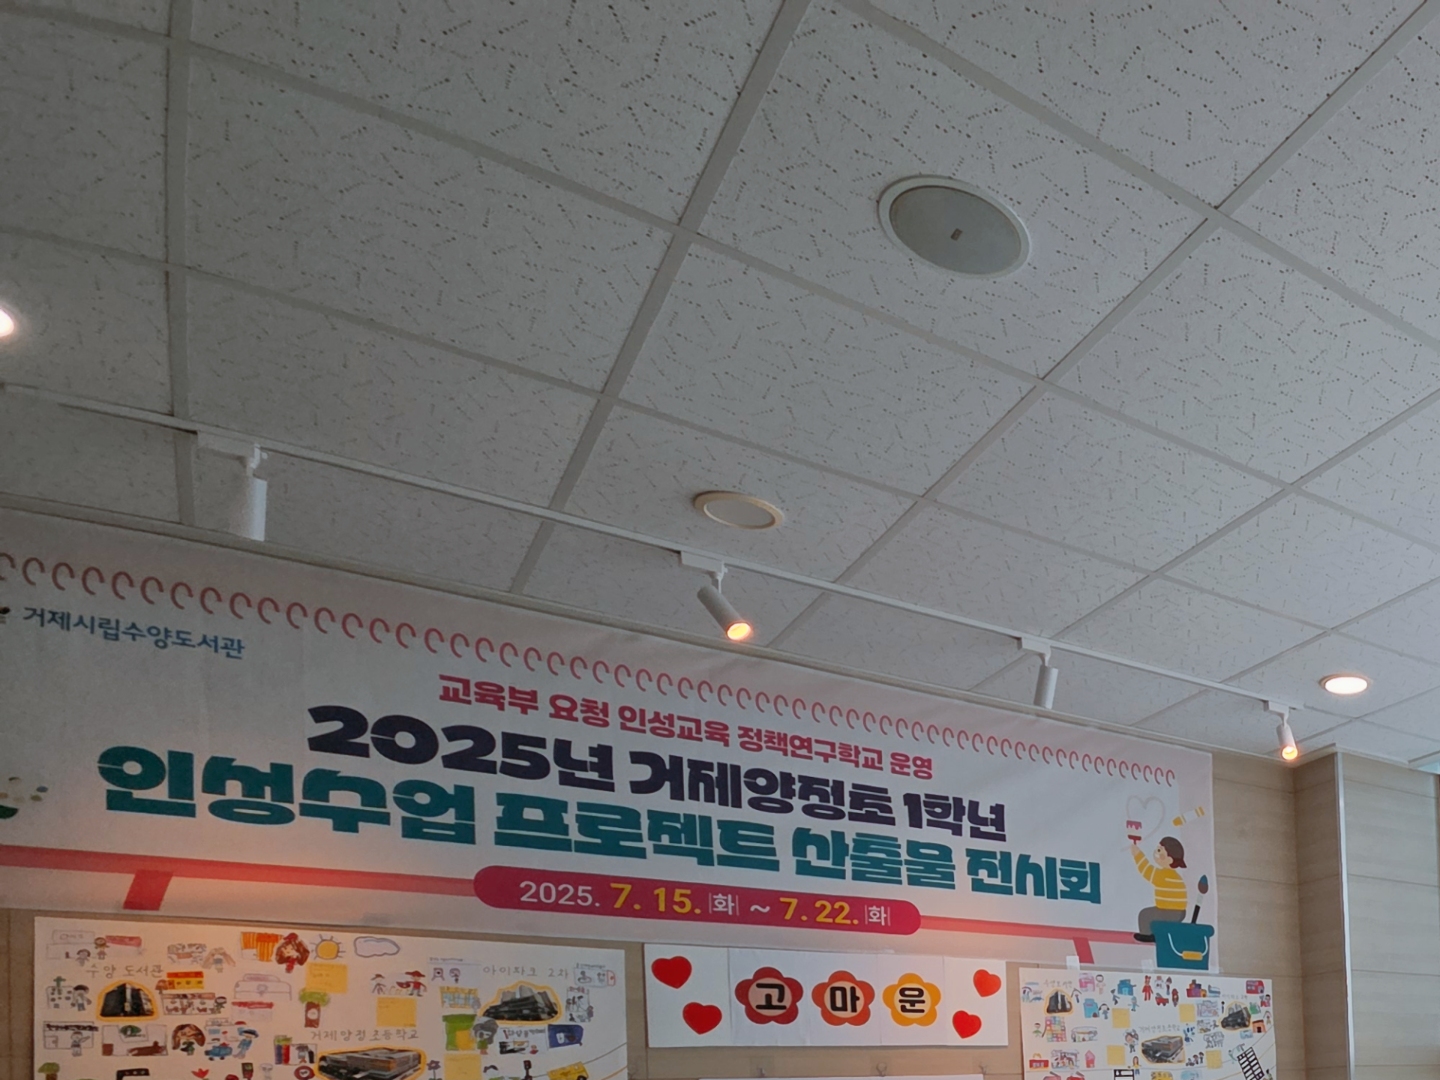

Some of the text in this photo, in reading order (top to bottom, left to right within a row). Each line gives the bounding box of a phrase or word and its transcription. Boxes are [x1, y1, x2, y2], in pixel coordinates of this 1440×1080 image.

[22, 606, 246, 660] 거제시립수양도서관
[439, 673, 934, 781] 교육부 요청 인성교육 정책연구학교 운영
[307, 704, 1007, 843] 2025년 거제양정초 1학년
[97, 744, 1102, 905] 인성수업 프로젝트 산출물 전시회
[518, 880, 600, 909] 2025.
[609, 882, 642, 911] 7.
[653, 887, 702, 916] 15.
[779, 897, 807, 922] 7.
[814, 899, 859, 927] 22.
[86, 963, 165, 980] 수양 도서관
[482, 964, 569, 980] 아이파크 2차
